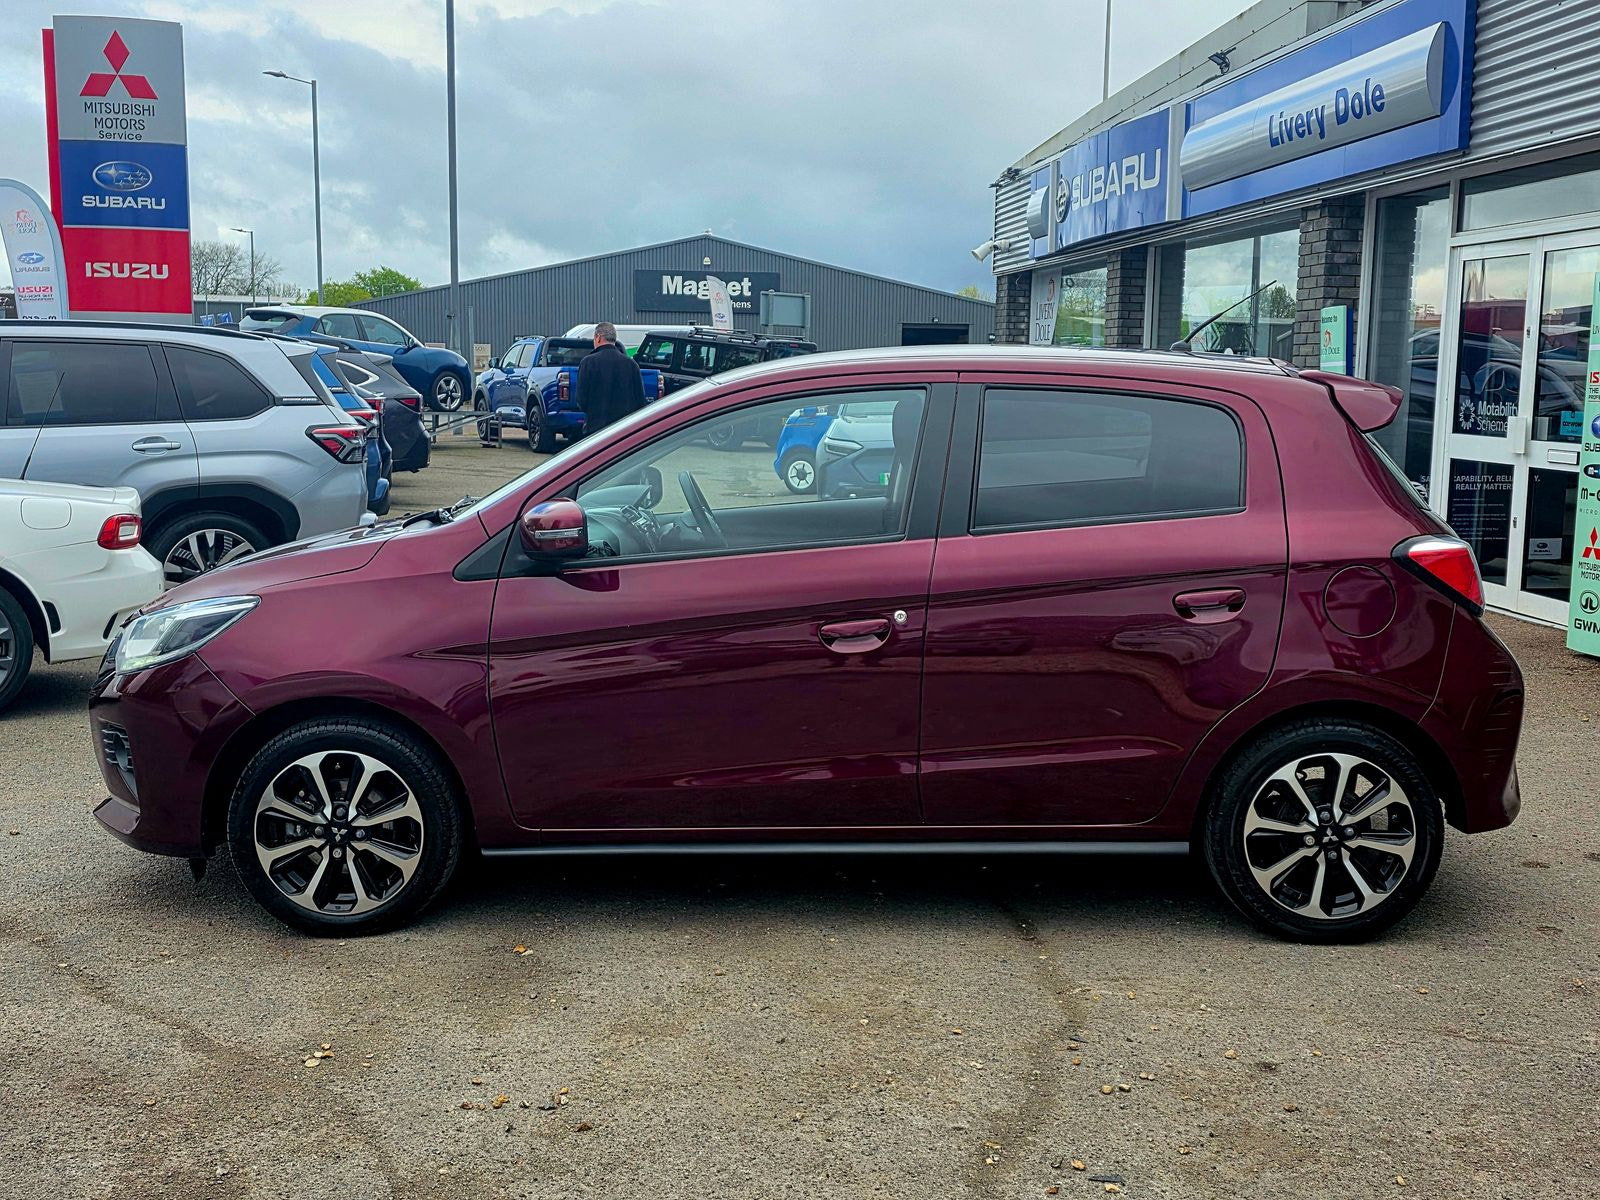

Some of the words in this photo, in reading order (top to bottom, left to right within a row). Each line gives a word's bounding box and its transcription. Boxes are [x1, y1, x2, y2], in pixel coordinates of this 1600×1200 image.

[84, 101, 156, 117] MITSUBISHI
[1268, 105, 1326, 148] Livery
[1335, 78, 1386, 126] Dole
[94, 117, 146, 131] MOTORS
[98, 130, 143, 141] Service
[1071, 148, 1162, 212] SUBARU
[82, 195, 166, 210] SUBARU
[85, 262, 169, 280] ISUZU
[662, 275, 752, 300] Maget
[1035, 301, 1055, 321] LIVERY
[1034, 322, 1051, 342] DOLE
[1477, 401, 1519, 417] Motability
[1476, 416, 1509, 432] Scheme
[1455, 483, 1482, 491] REALLY
